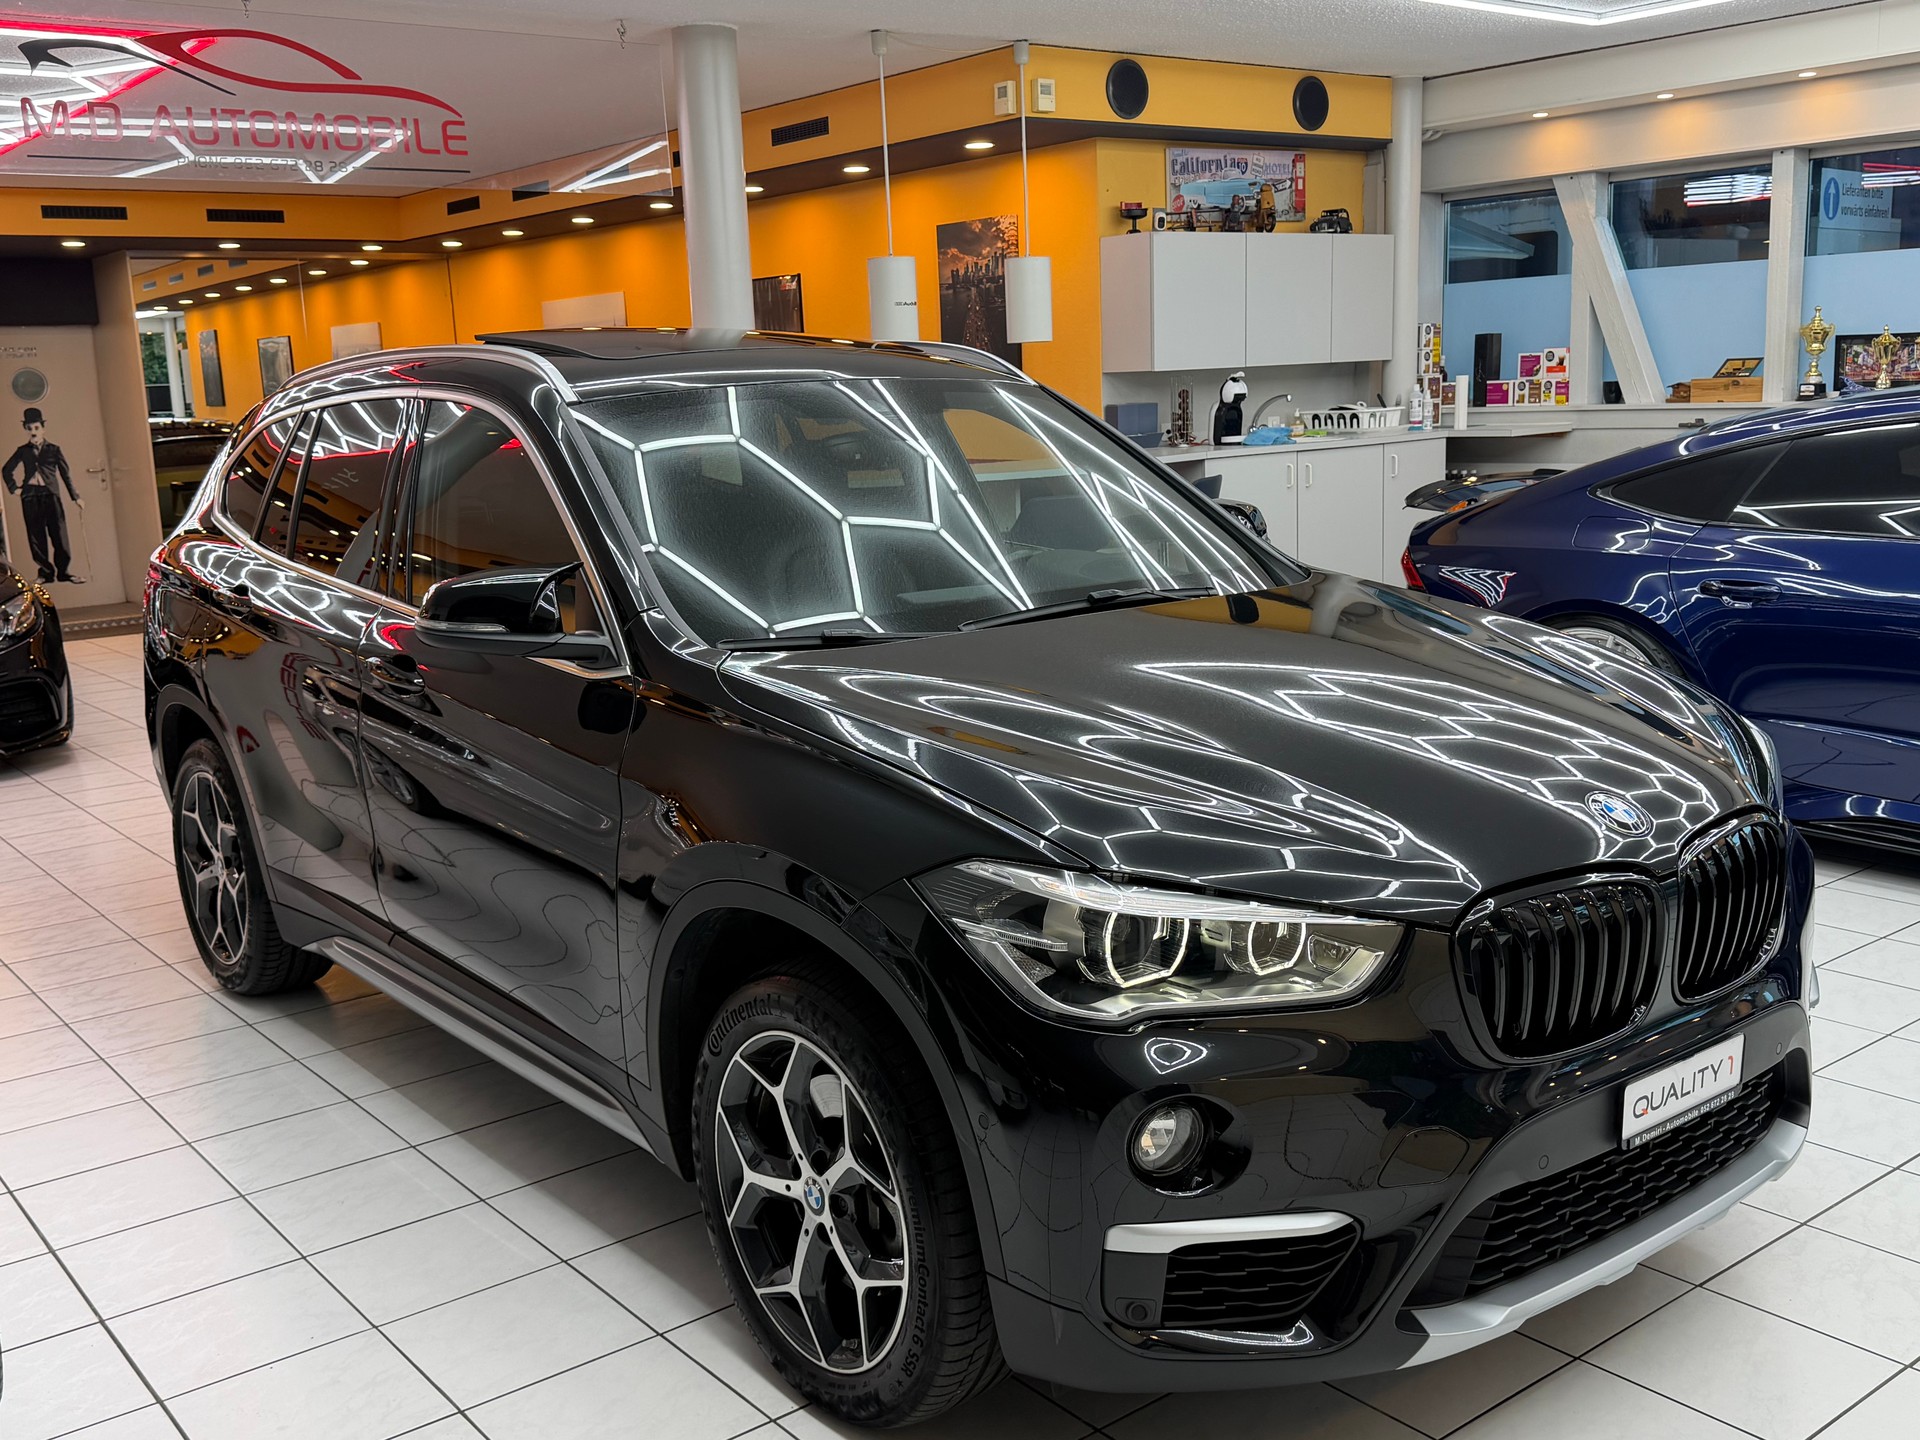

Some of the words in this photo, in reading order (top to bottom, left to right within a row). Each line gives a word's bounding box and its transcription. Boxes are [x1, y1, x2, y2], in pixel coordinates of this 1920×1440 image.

[304, 160, 324, 173] 28
[1171, 154, 1236, 176] California
[1842, 183, 1871, 198] Lieferanten
[1872, 186, 1884, 199] bitte
[1841, 204, 1863, 217] vorwärts
[1864, 204, 1890, 219] einfahren!
[707, 993, 774, 1057] Continental
[1632, 1059, 1724, 1119] QUALITY
[1728, 1055, 1734, 1075] 1
[903, 1174, 931, 1327] PremiumContact
[912, 1336, 923, 1347] 6
[900, 1350, 920, 1378] SSR
